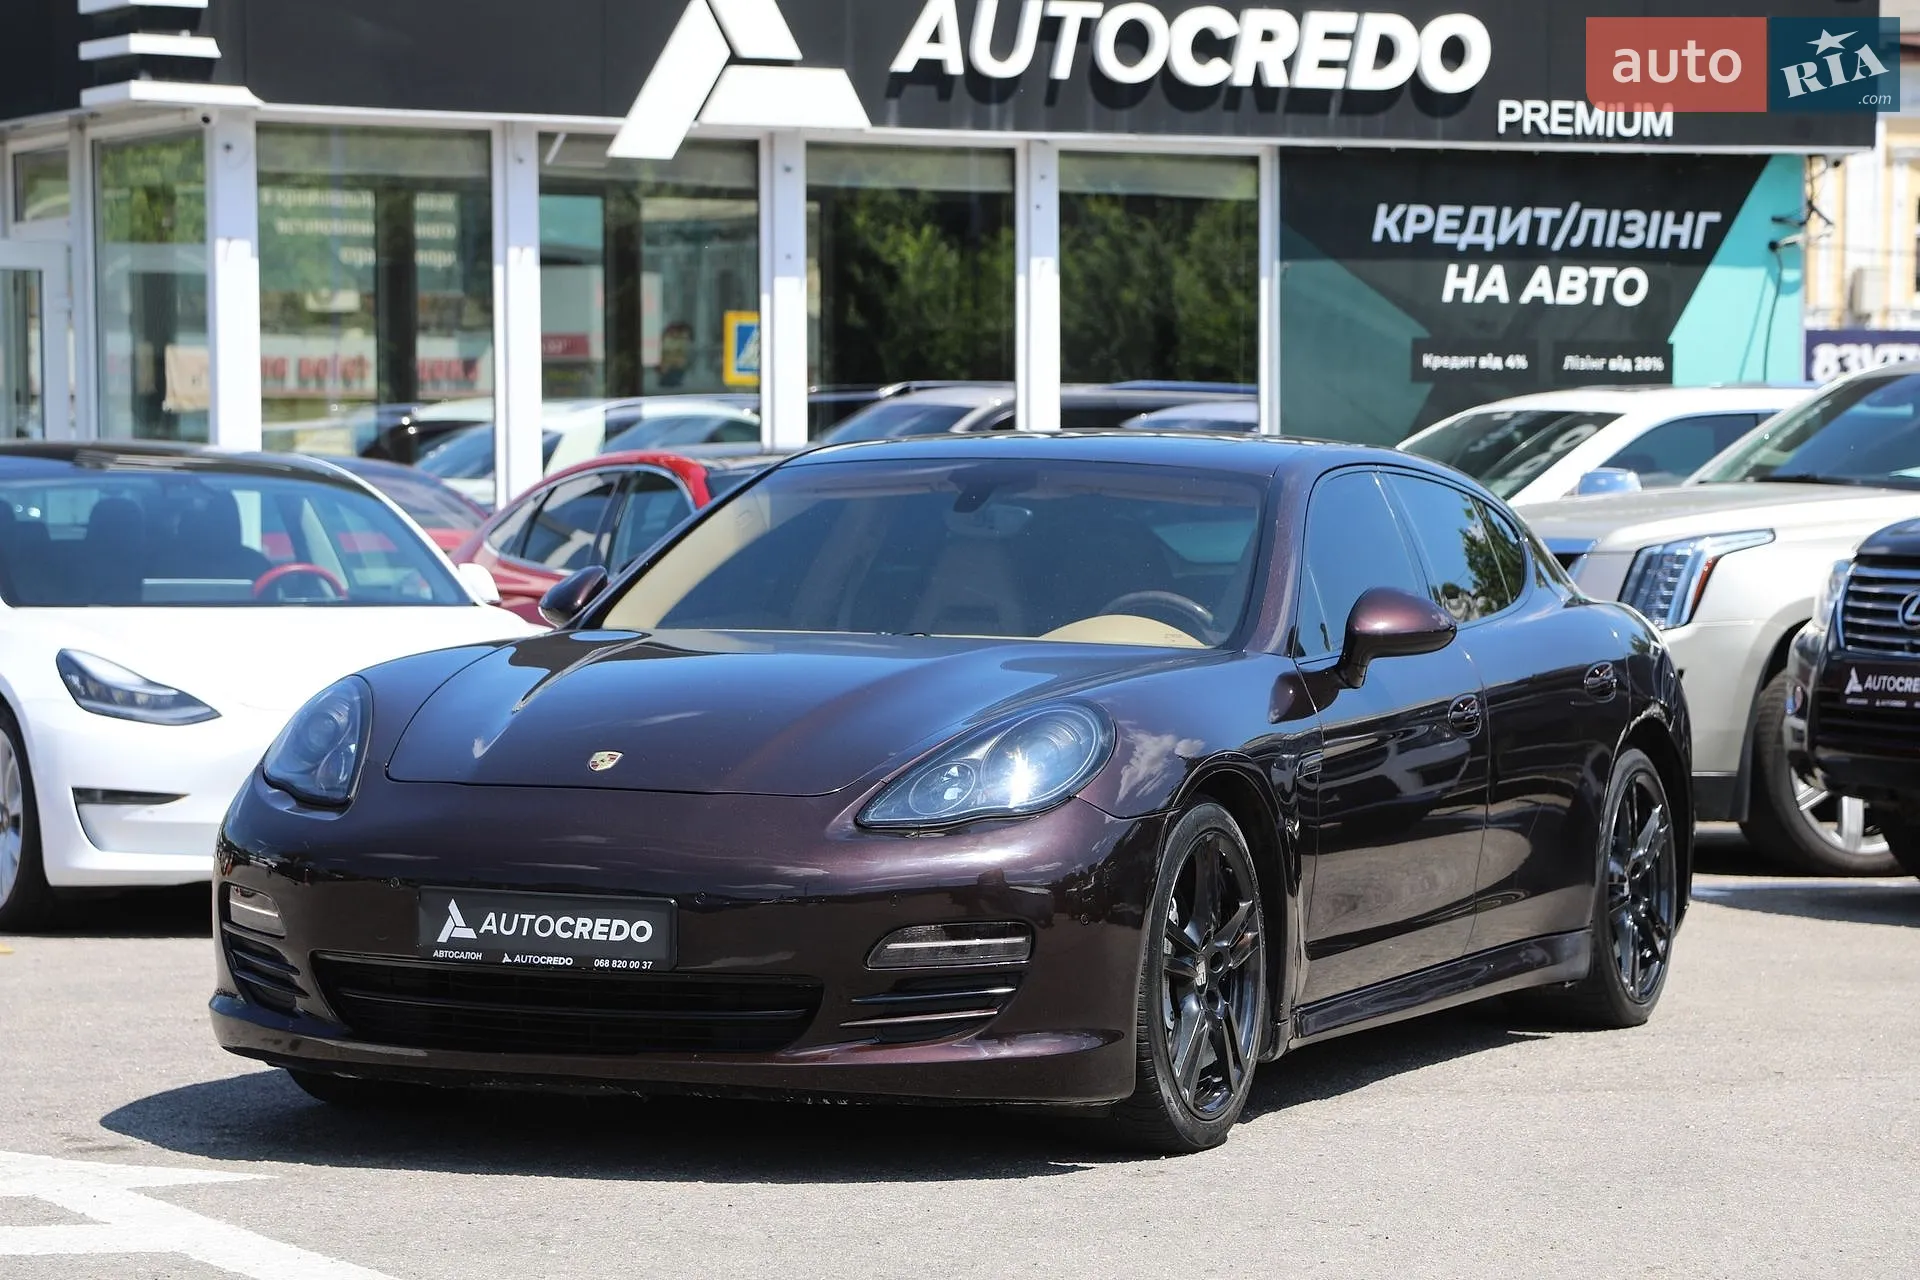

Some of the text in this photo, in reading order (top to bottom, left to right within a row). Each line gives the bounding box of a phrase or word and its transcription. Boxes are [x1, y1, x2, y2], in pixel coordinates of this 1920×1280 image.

[890, 0, 1491, 94] AUTOCREDO
[1498, 100, 1674, 138] PREMIUM
[1371, 201, 1722, 251] КРЕДИТ/ЛІЗІНГ
[1442, 264, 1649, 306] НА АВТО
[1422, 353, 1477, 371] Кредит
[1504, 354, 1528, 370] 4%
[479, 911, 653, 943] AUTOCREDO
[433, 950, 482, 961] АВТОСАЛОН
[513, 954, 574, 966] AUTOCREDO
[594, 958, 653, 970] 068 820 00 37
